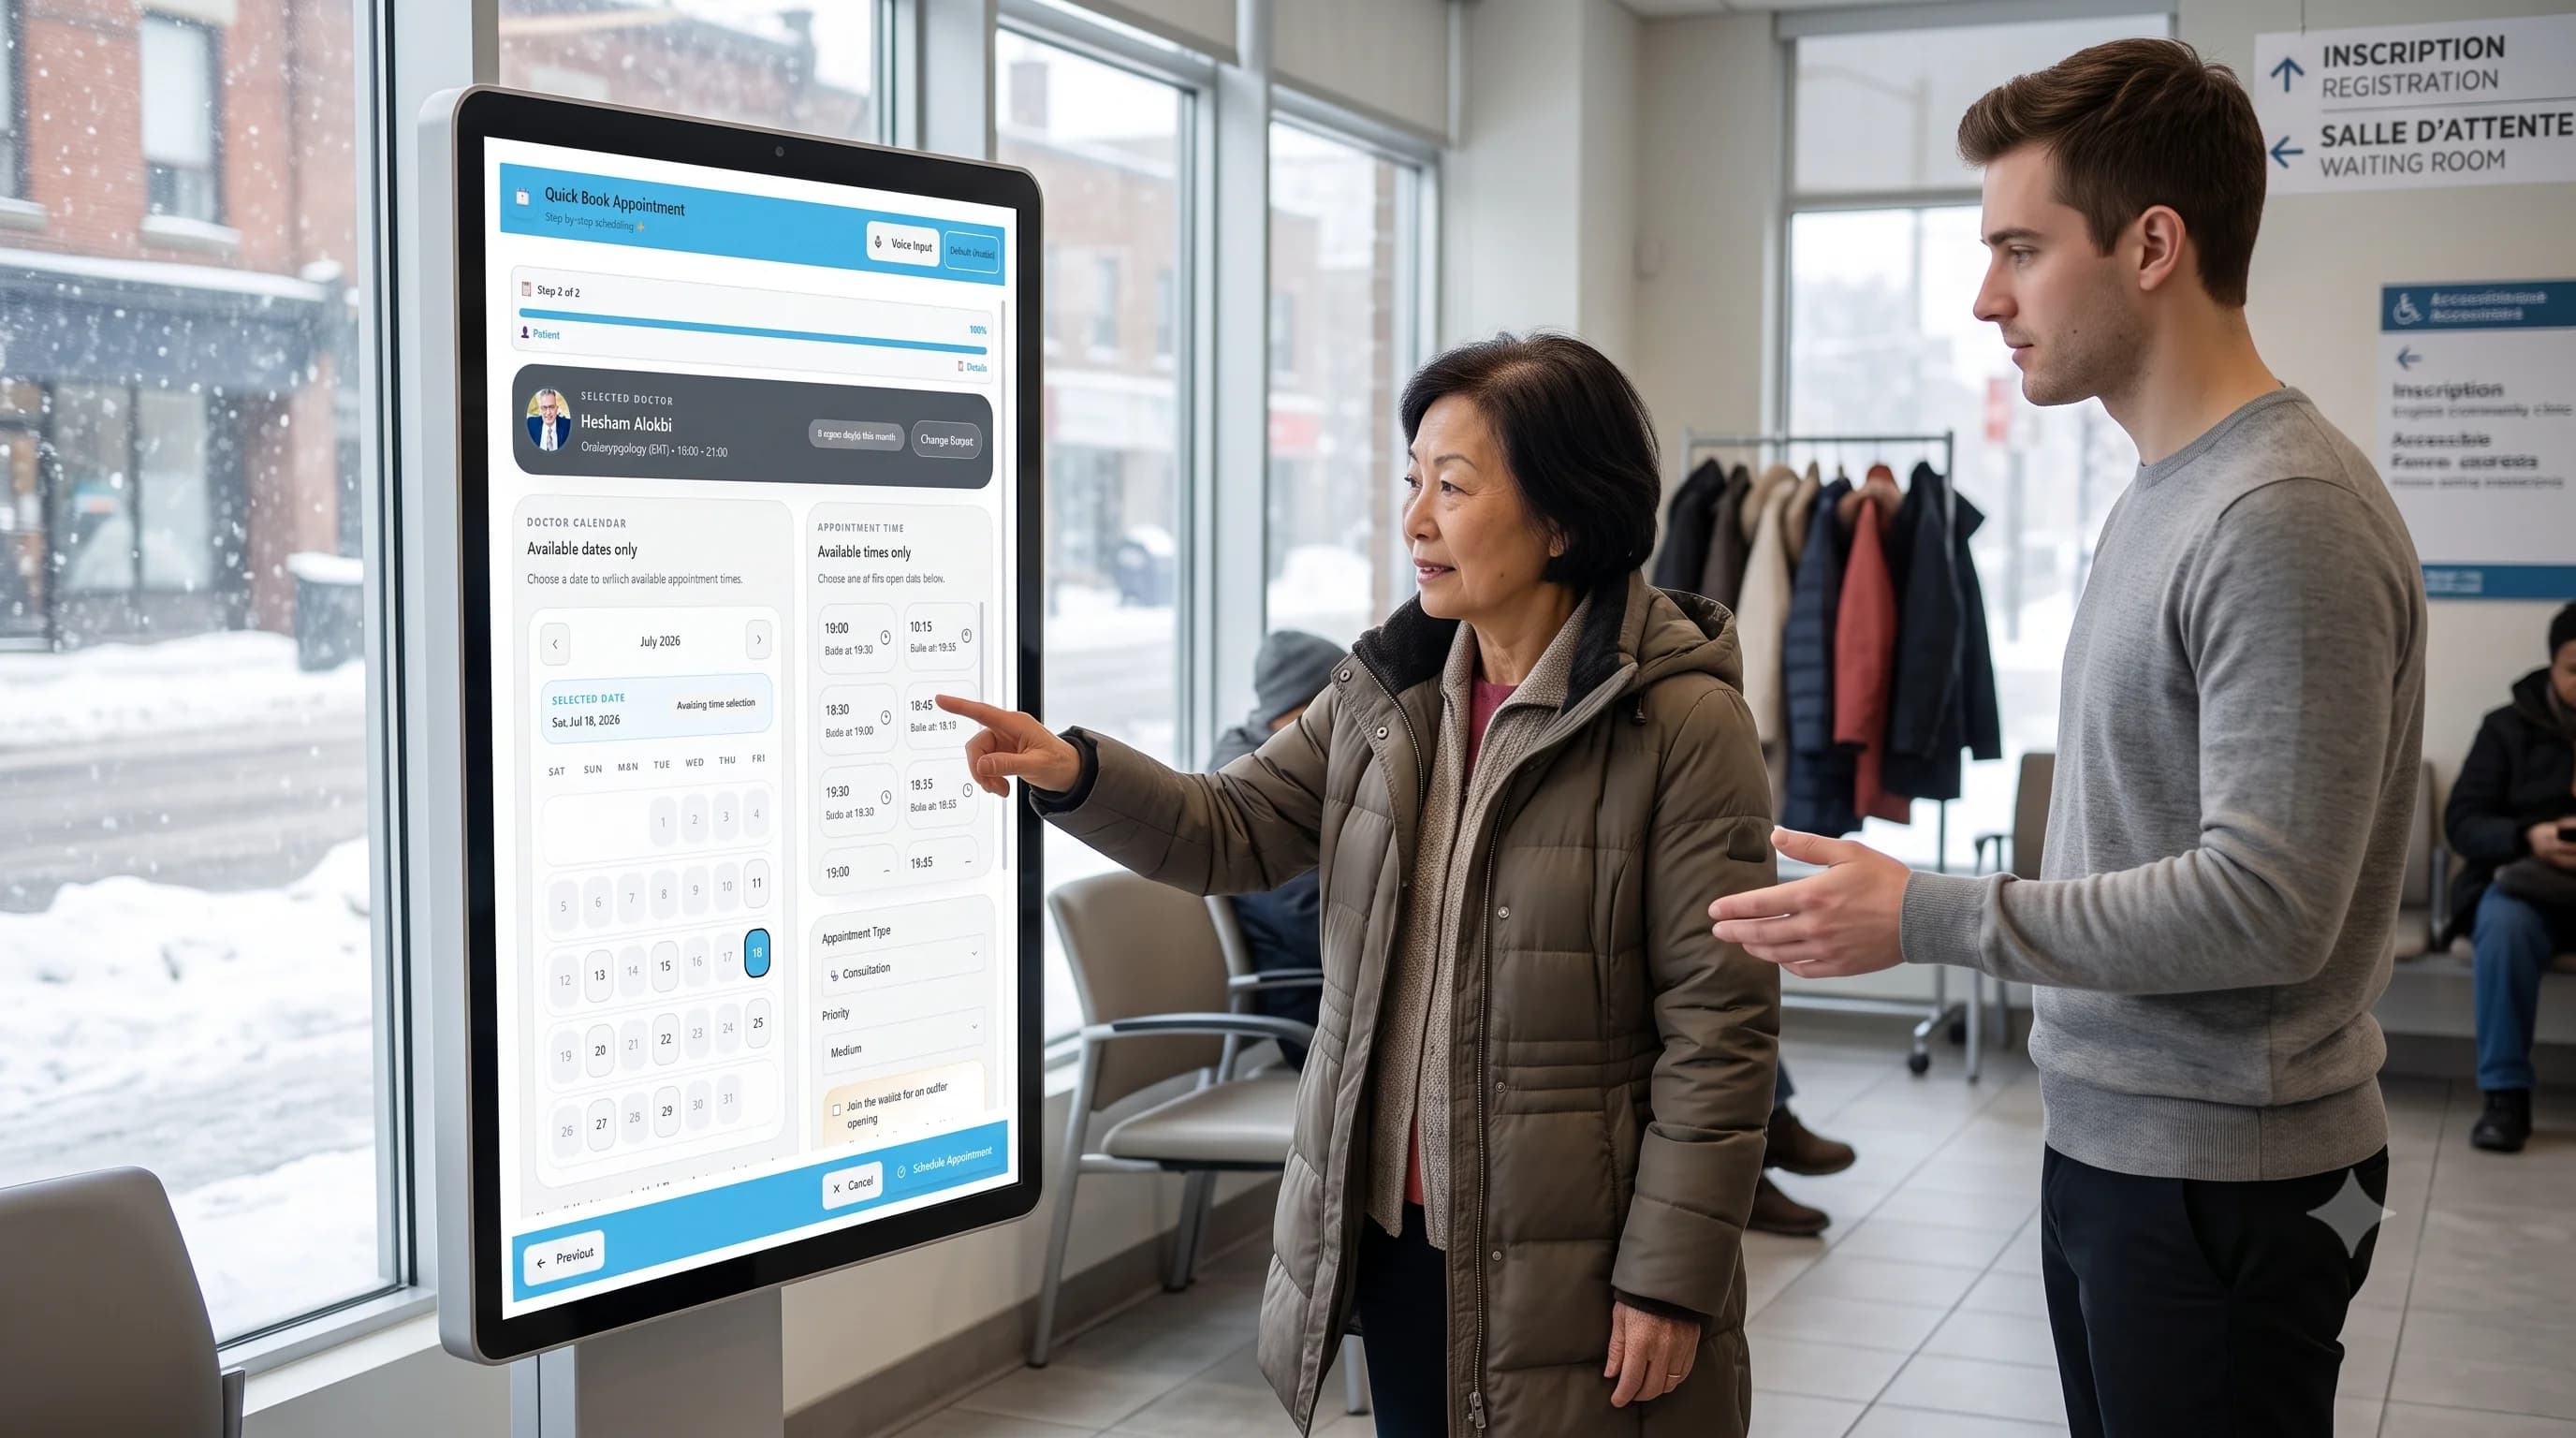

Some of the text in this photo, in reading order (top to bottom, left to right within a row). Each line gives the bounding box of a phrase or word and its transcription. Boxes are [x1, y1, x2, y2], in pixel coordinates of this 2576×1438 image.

[2323, 35, 2506, 67] INSCRIPTION
[2322, 68, 2498, 98] REGISTRATION
[2320, 112, 2575, 148] SALLE D'ATTENTE
[2320, 150, 2506, 178] WAITING ROOM
[545, 186, 686, 216] Quick Book Appointment
[545, 212, 563, 226] Step
[891, 238, 932, 254] Voice Input
[537, 285, 580, 298] Step 2 of 2
[533, 329, 561, 340] Patient
[970, 325, 988, 335] 100%
[580, 390, 674, 406] SELECTED DOCTOR
[2392, 382, 2505, 401] Inscription
[580, 414, 673, 433] Hesham Alokbi
[920, 433, 949, 448] Change
[677, 446, 699, 457] 16:00
[706, 447, 728, 458] 21:00
[527, 517, 626, 529] DOCTOR CALENDAR
[817, 522, 904, 533] APPOINTMENT TIME
[527, 541, 637, 560] Available dates only
[817, 545, 912, 563] Available times only
[527, 573, 559, 585] Choose
[562, 576, 567, 584] a
[569, 573, 588, 585] date
[591, 575, 600, 584] to
[631, 573, 666, 585] available
[667, 573, 718, 587] appointment
[720, 573, 743, 585] times.
[817, 573, 845, 584] Choose
[886, 575, 904, 586] open
[825, 622, 849, 634] 19:00
[640, 636, 681, 650] July 2026
[844, 646, 853, 655] at
[552, 693, 625, 706] SELECTED DATE
[709, 699, 724, 709] time
[725, 697, 756, 708] selection
[910, 699, 933, 712] 18:45
[825, 703, 849, 716] 18:30
[569, 715, 582, 727] Jul
[585, 715, 597, 727] 18,
[598, 714, 621, 726] 2026
[549, 767, 565, 777] SAT
[583, 764, 603, 774] SUN
[653, 760, 671, 770] TUE
[685, 757, 705, 768] WED
[718, 756, 736, 765] THU
[752, 754, 766, 763] FRI
[826, 785, 850, 799] 19:30
[692, 814, 698, 825] 2
[723, 811, 729, 822] 3
[754, 809, 760, 819] 4
[826, 865, 850, 879] 19:00
[561, 878, 761, 912] 5 6 7 8 9 10 11
[559, 946, 763, 987] 12 13 14 15 16 17 18
[822, 1006, 850, 1021] Priority
[560, 1017, 764, 1063] 19 20 21 22 23 24 25
[830, 1044, 862, 1059] Medium
[864, 1097, 876, 1108] the
[903, 1089, 914, 1099] for
[562, 1125, 574, 1137] 26
[596, 1118, 607, 1130] 27
[662, 1105, 673, 1117] 29
[693, 1099, 704, 1110] 30
[724, 1093, 734, 1105] 31
[847, 1114, 878, 1130] opening
[946, 1146, 993, 1167] Appointment
[848, 1176, 873, 1191] Cancel
